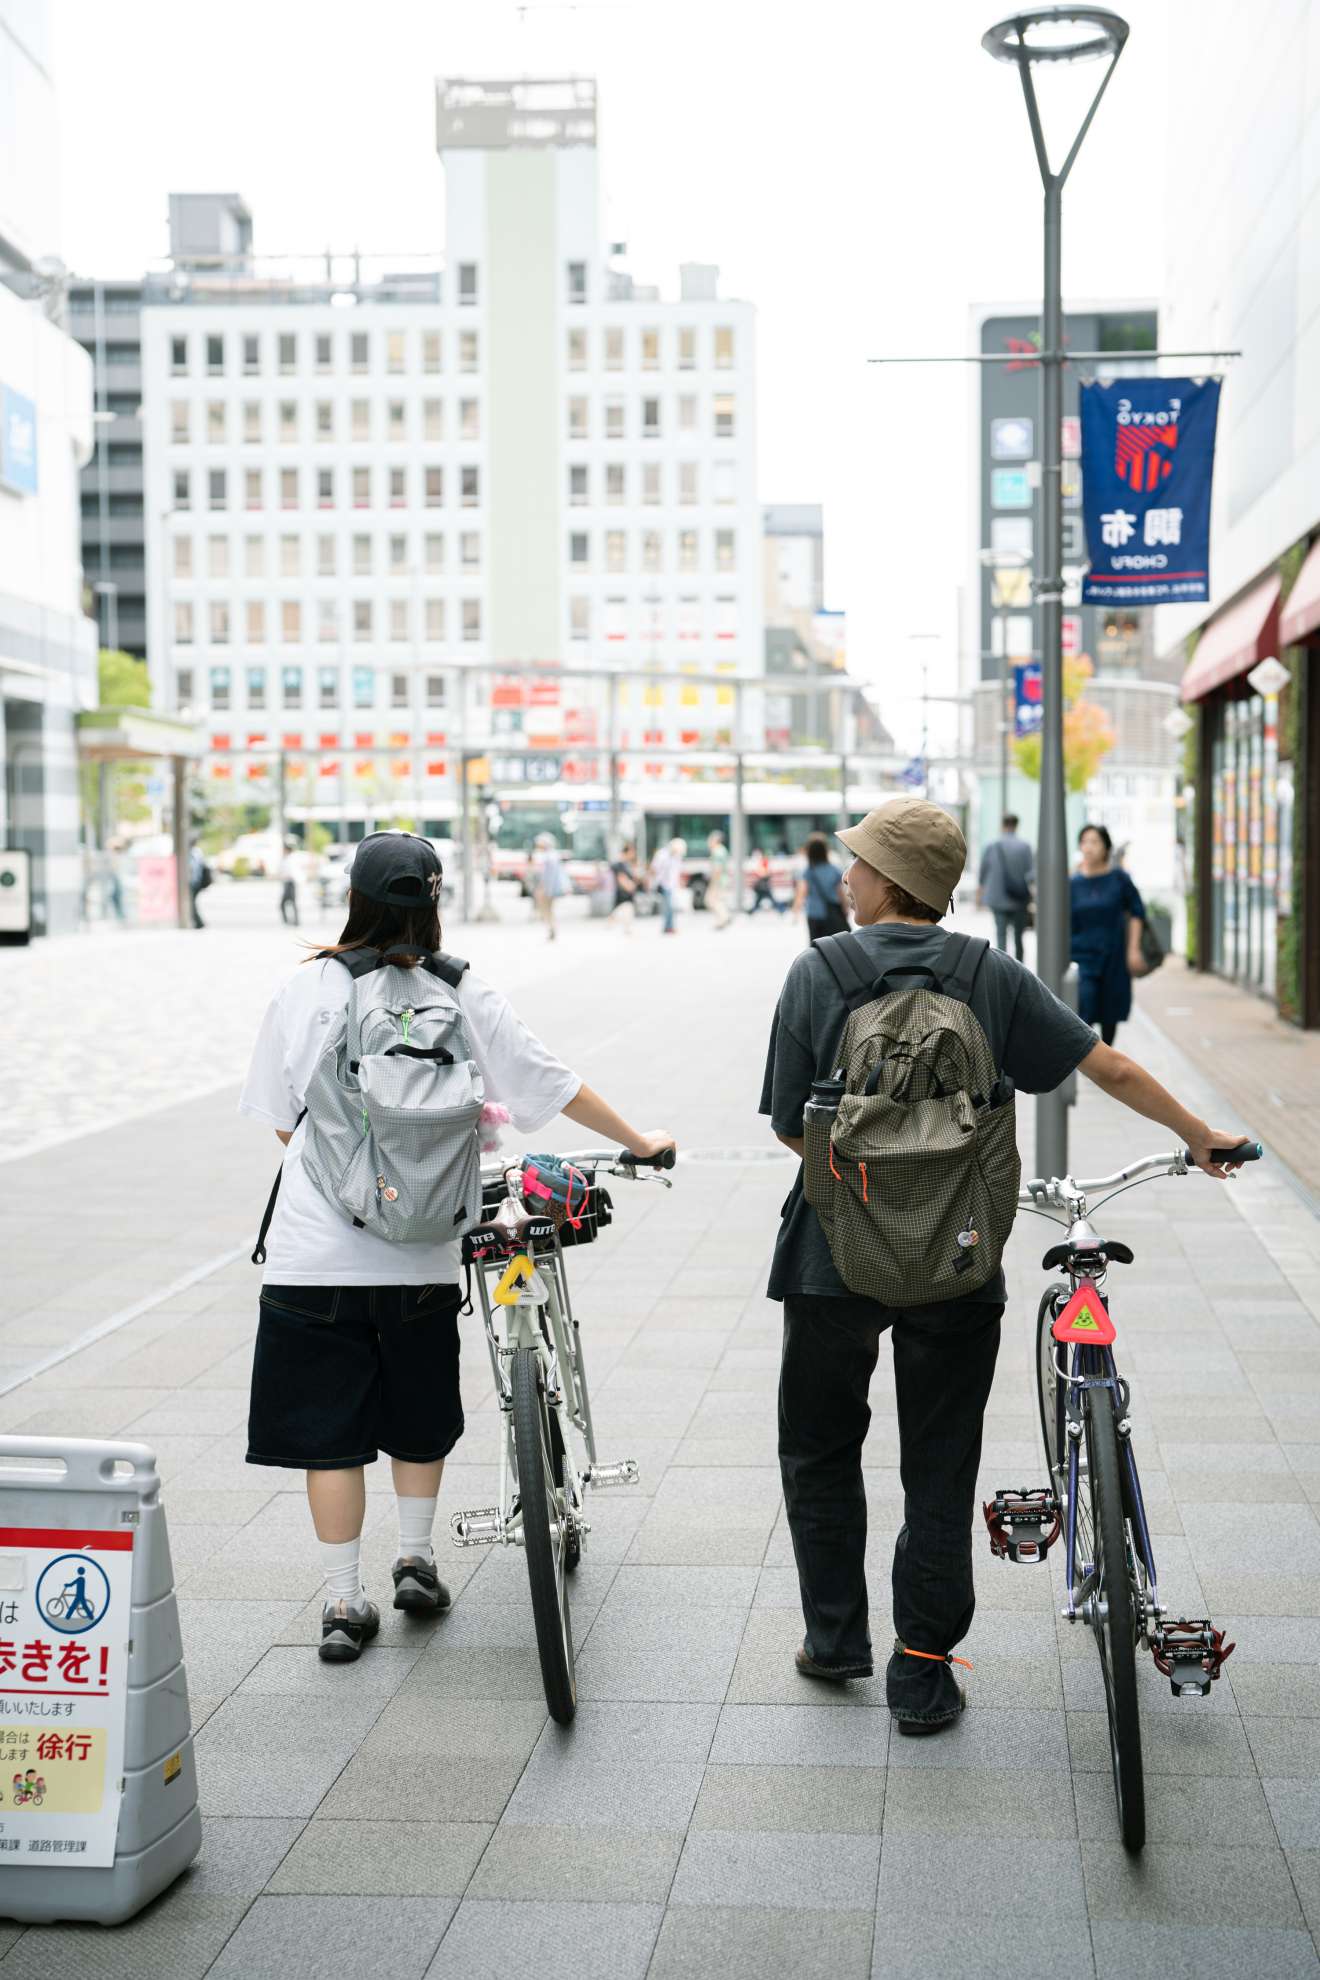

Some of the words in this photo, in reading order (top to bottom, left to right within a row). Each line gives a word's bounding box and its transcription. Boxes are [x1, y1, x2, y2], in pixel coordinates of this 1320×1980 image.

[36, 1732, 92, 1761] 徐行
[28, 1839, 87, 1853] 道路管理課
